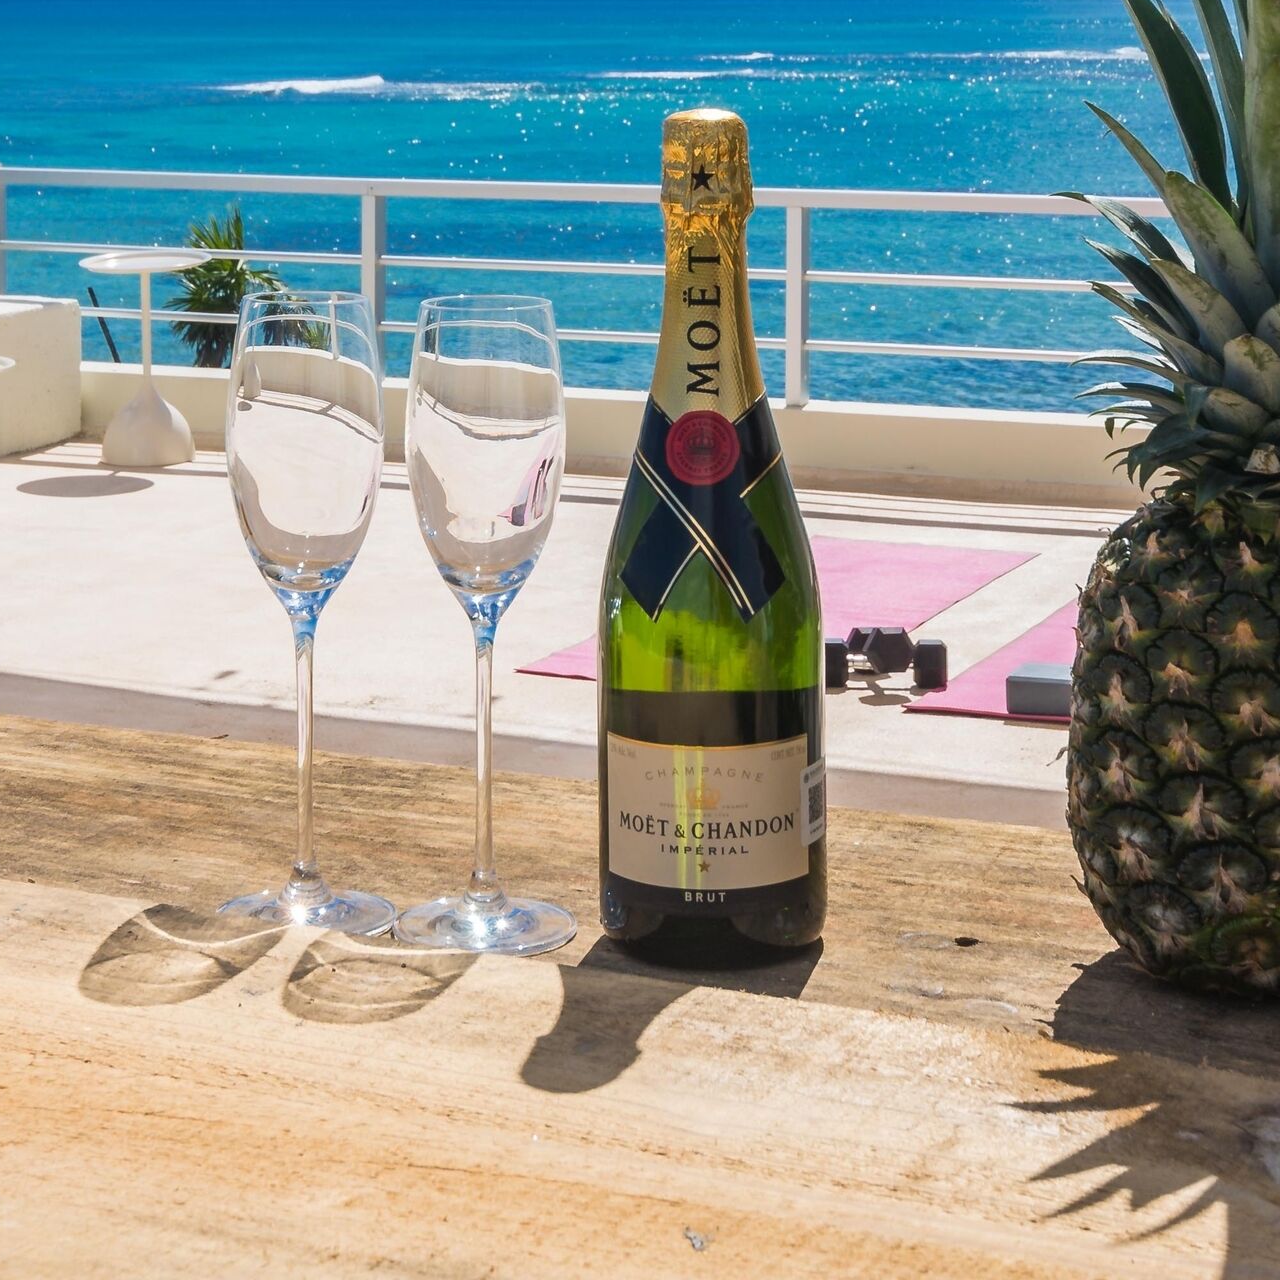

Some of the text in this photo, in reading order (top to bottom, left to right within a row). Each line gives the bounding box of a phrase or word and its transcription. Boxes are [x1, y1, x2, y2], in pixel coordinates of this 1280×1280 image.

[682, 246, 721, 397] MOËT
[644, 766, 765, 783] CHAMPAGNE
[619, 810, 669, 837] MOËT
[674, 823, 686, 839] &
[691, 812, 795, 840] CHANDON
[661, 844, 749, 856] IMPÉRIAL
[684, 891, 726, 903] BRUT
